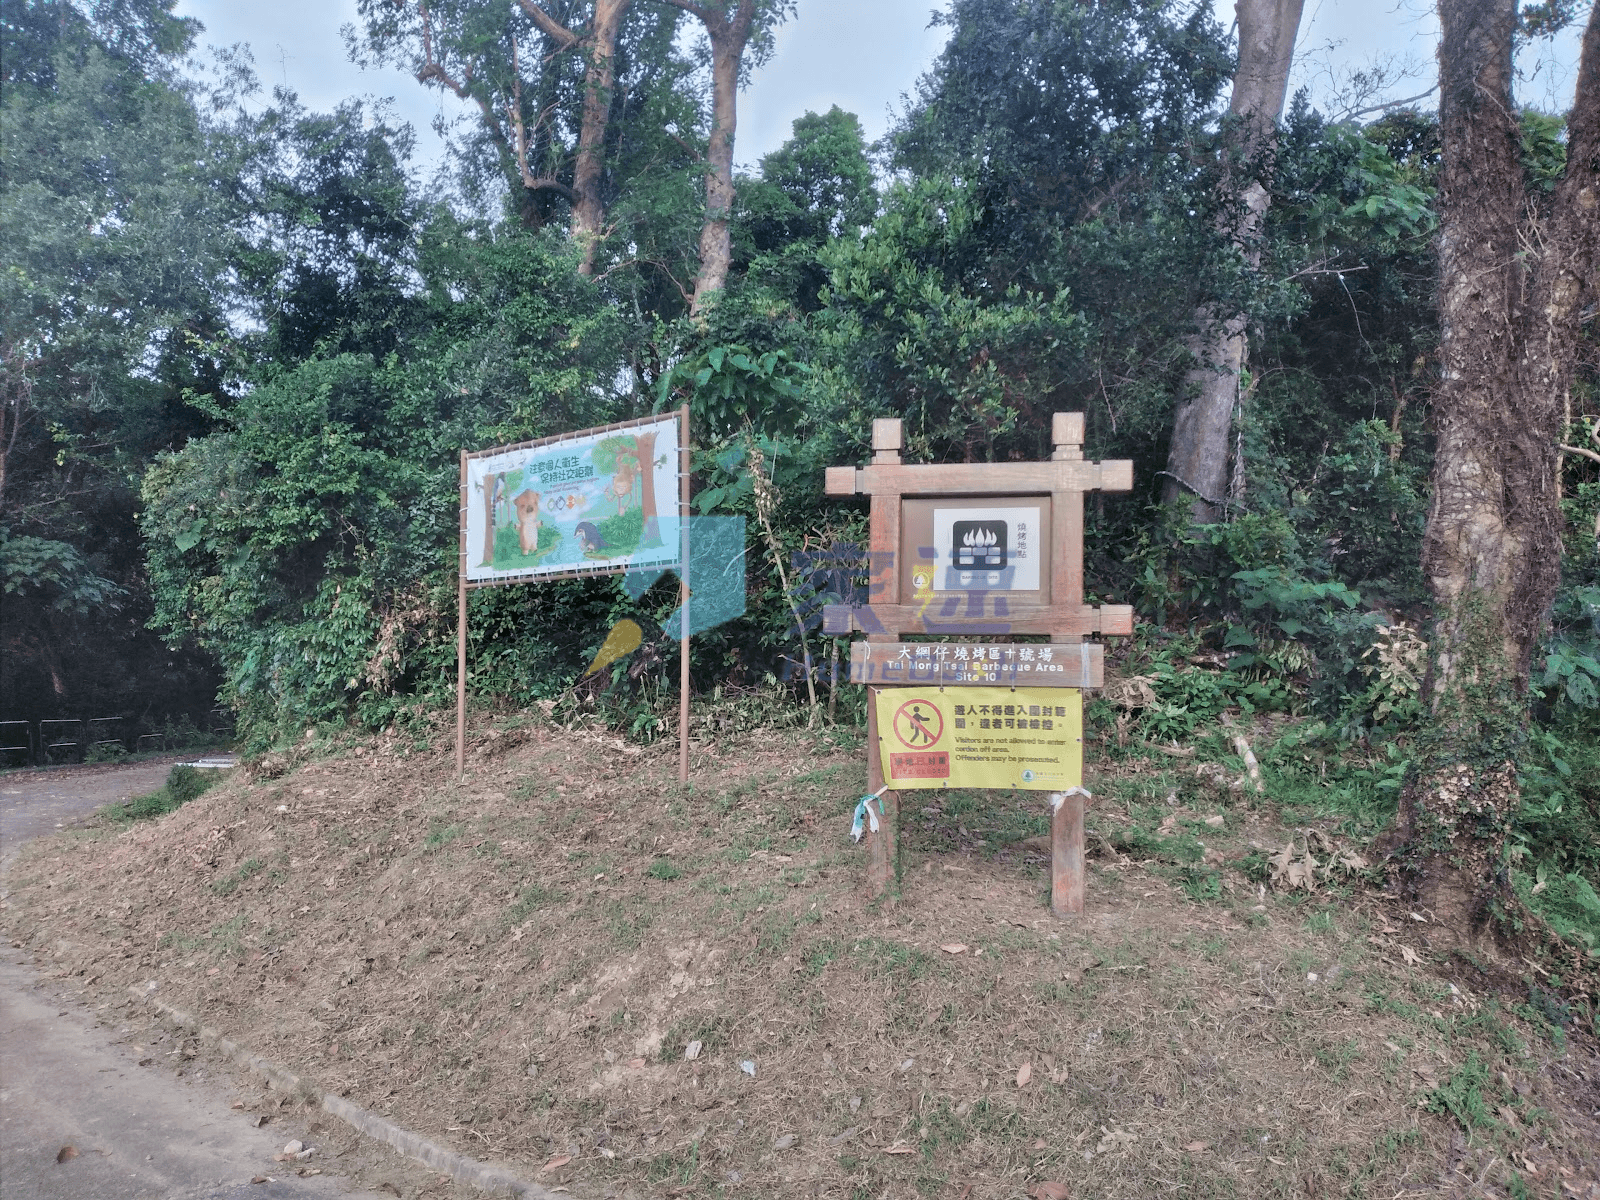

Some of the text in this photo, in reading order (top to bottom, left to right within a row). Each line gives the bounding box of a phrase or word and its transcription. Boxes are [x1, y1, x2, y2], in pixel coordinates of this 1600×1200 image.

[540, 465, 594, 484] 保持社交距離
[1017, 522, 1027, 558] 燒烤地點
[899, 646, 1054, 662] 大網仔燒烤區十號場
[887, 661, 904, 670] Tai
[908, 661, 940, 672] Mong
[945, 661, 968, 671] Tsai
[1035, 663, 1064, 672] Area
[955, 671, 997, 682] Site 10
[955, 736, 981, 744] Visitors
[955, 754, 991, 762] Offenders
[991, 756, 1008, 764] may
